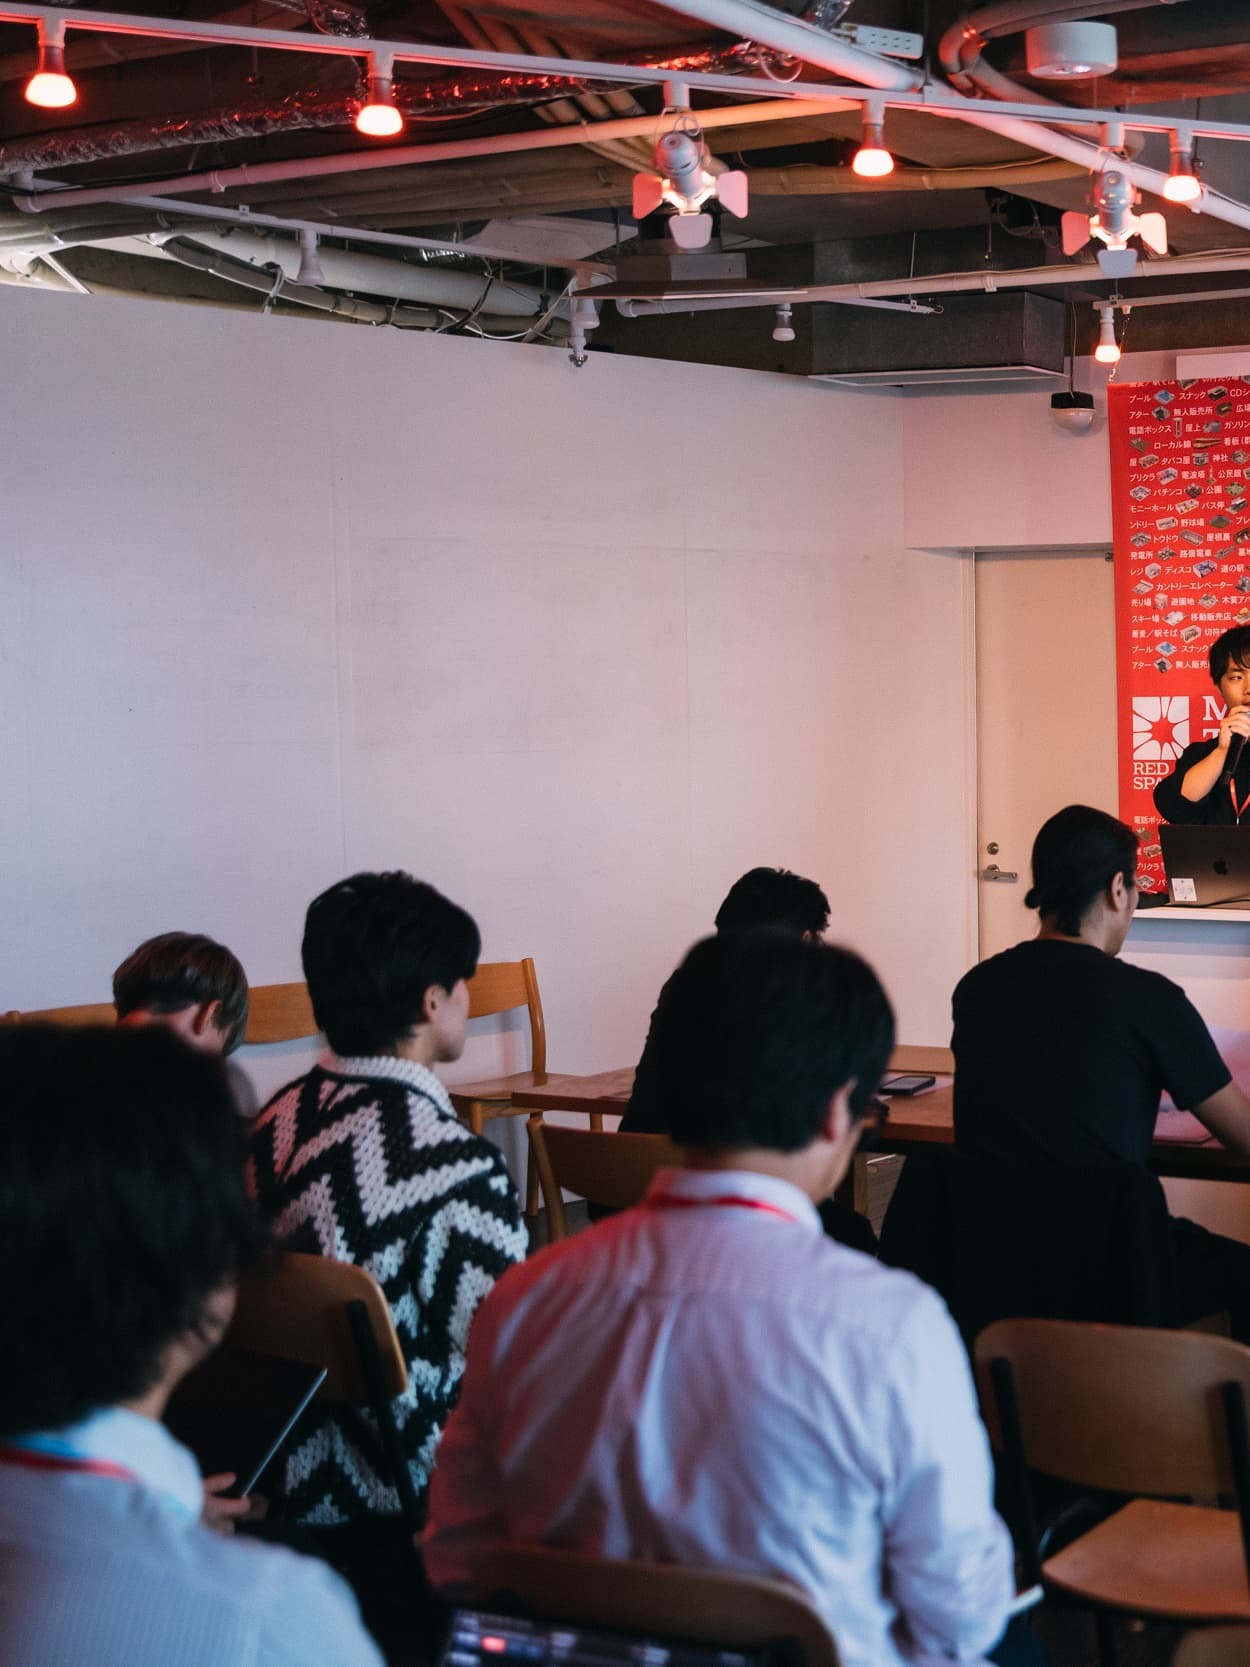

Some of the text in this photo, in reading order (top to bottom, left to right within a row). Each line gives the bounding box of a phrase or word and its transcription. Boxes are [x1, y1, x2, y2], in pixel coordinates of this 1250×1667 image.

[1179, 391, 1206, 400] スナック
[1129, 411, 1149, 419] アター
[1130, 504, 1175, 513] モニーホール
[1129, 520, 1154, 529] ンドリー
[1131, 567, 1143, 576] レジ
[1164, 565, 1192, 574] ディスコ
[1156, 582, 1233, 591] カントリーエレベーター
[1133, 762, 1170, 775] RED
